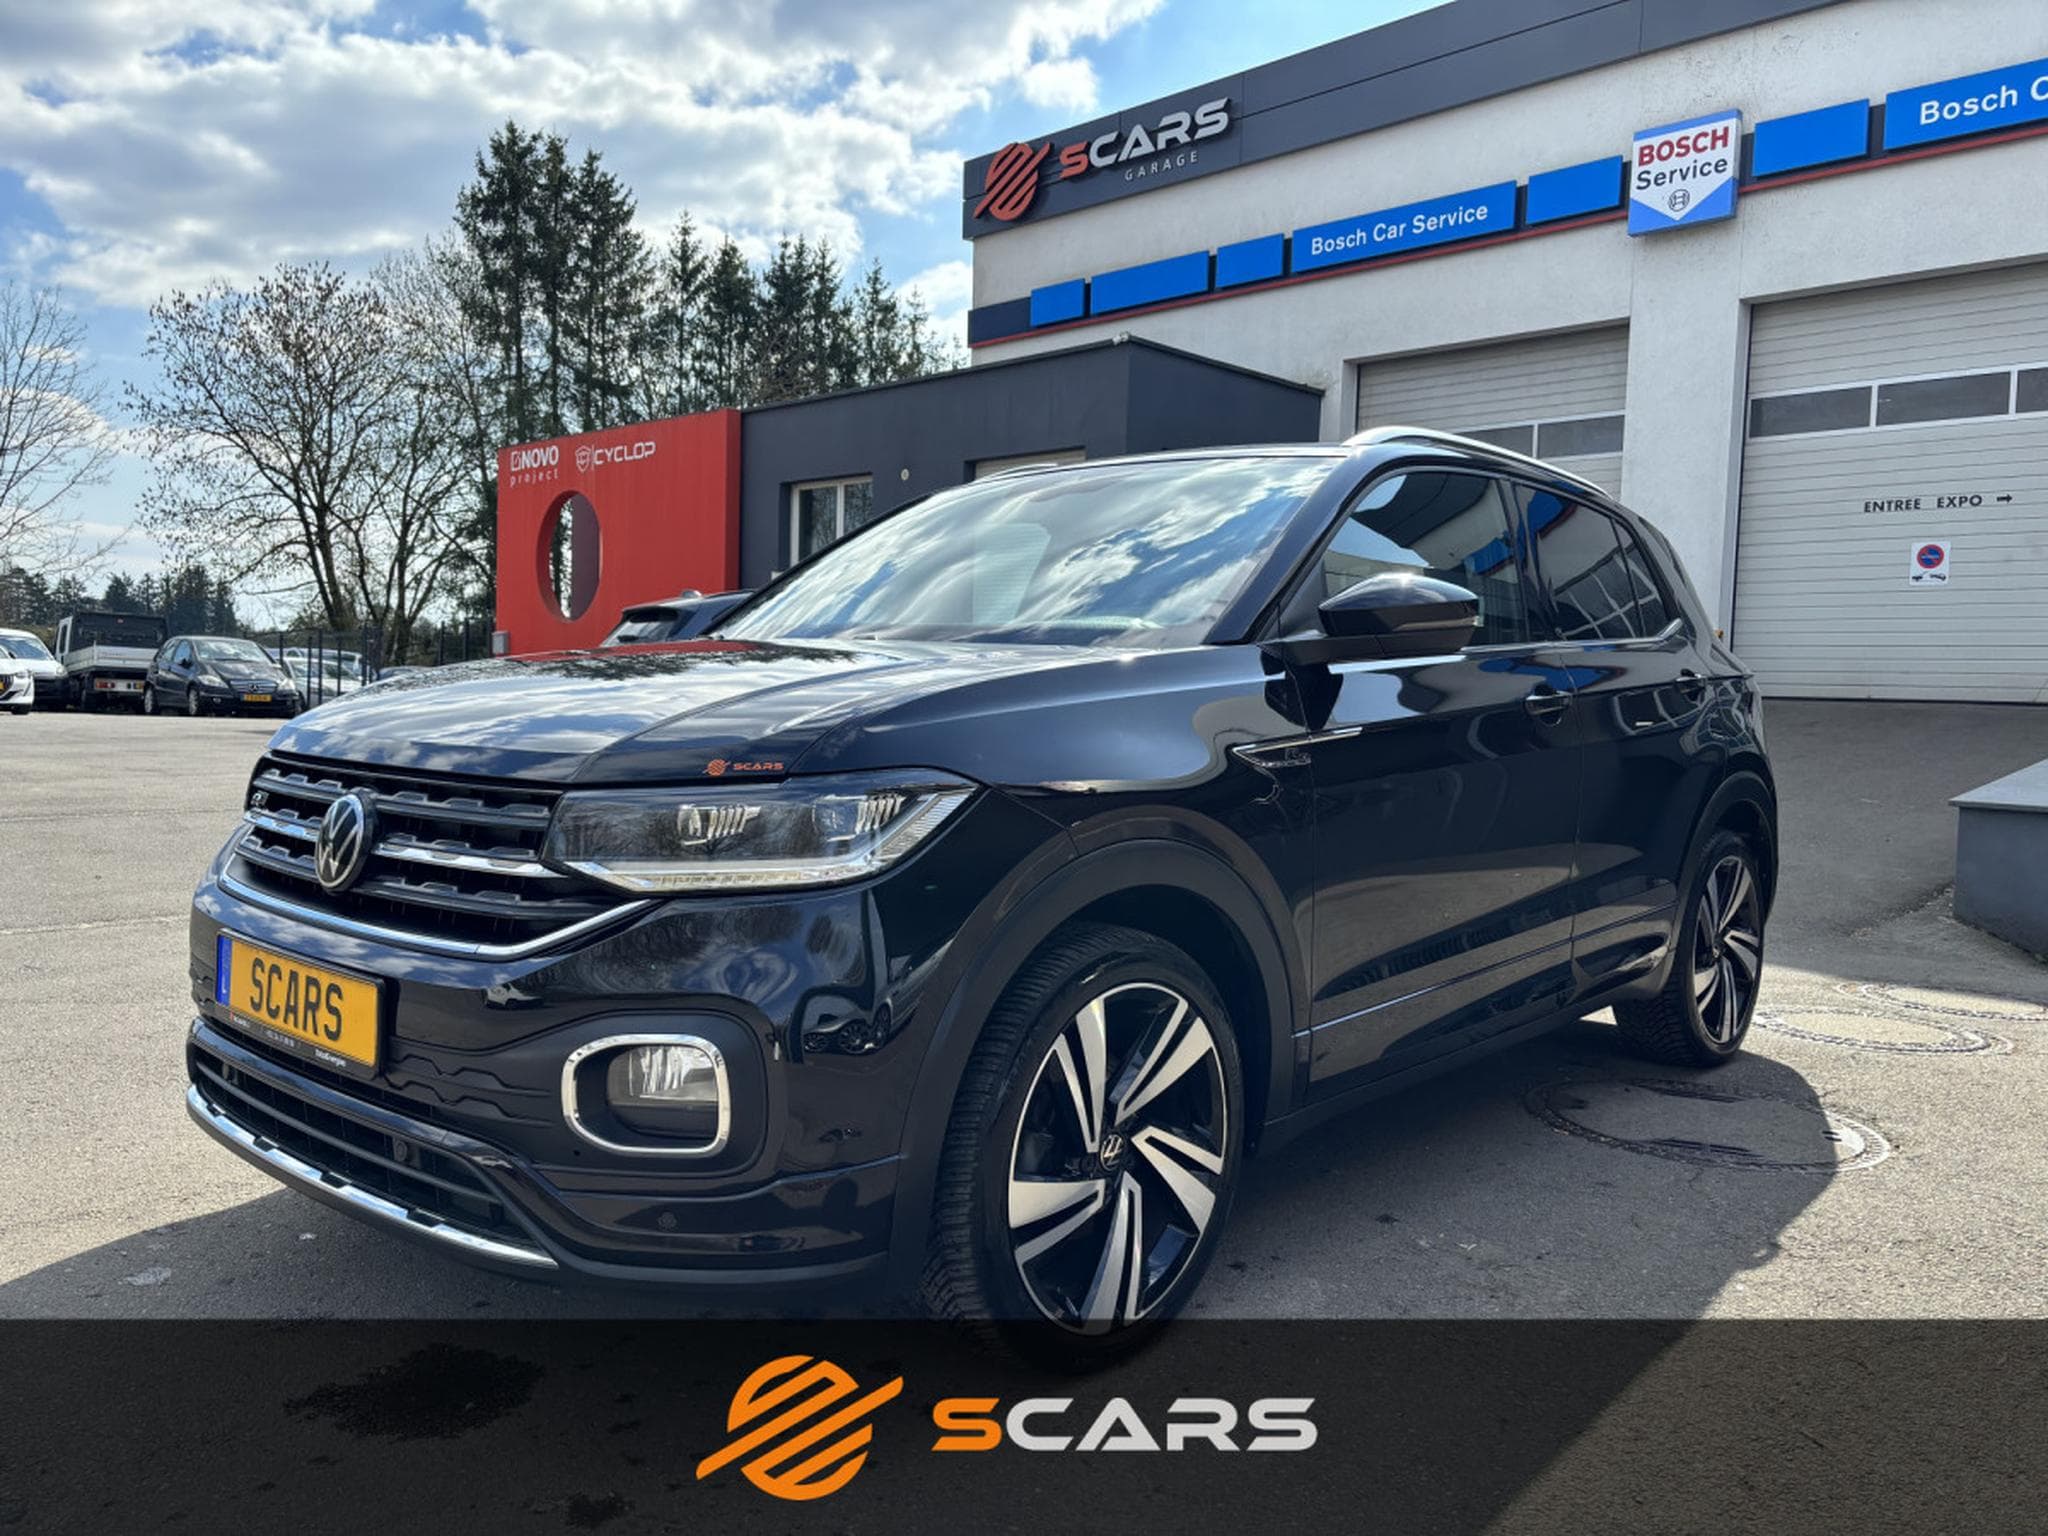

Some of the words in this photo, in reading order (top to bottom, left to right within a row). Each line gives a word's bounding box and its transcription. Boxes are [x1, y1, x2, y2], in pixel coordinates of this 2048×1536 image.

[1920, 85, 2018, 126] Bosch
[1059, 97, 1230, 179] SCARS
[1638, 126, 1729, 167] BOSCH
[1124, 150, 1199, 181] GARAGE
[1636, 157, 1728, 190] Service
[1311, 227, 1367, 256] Bosch
[1373, 222, 1406, 243] Car
[1412, 204, 1489, 234] Service
[593, 441, 656, 466] CYCLOP
[510, 468, 559, 488] project
[1864, 498, 1921, 513] ENTREE
[1936, 494, 1983, 509] EXPO
[733, 762, 784, 771] SCARS
[250, 957, 344, 1042] SCARS
